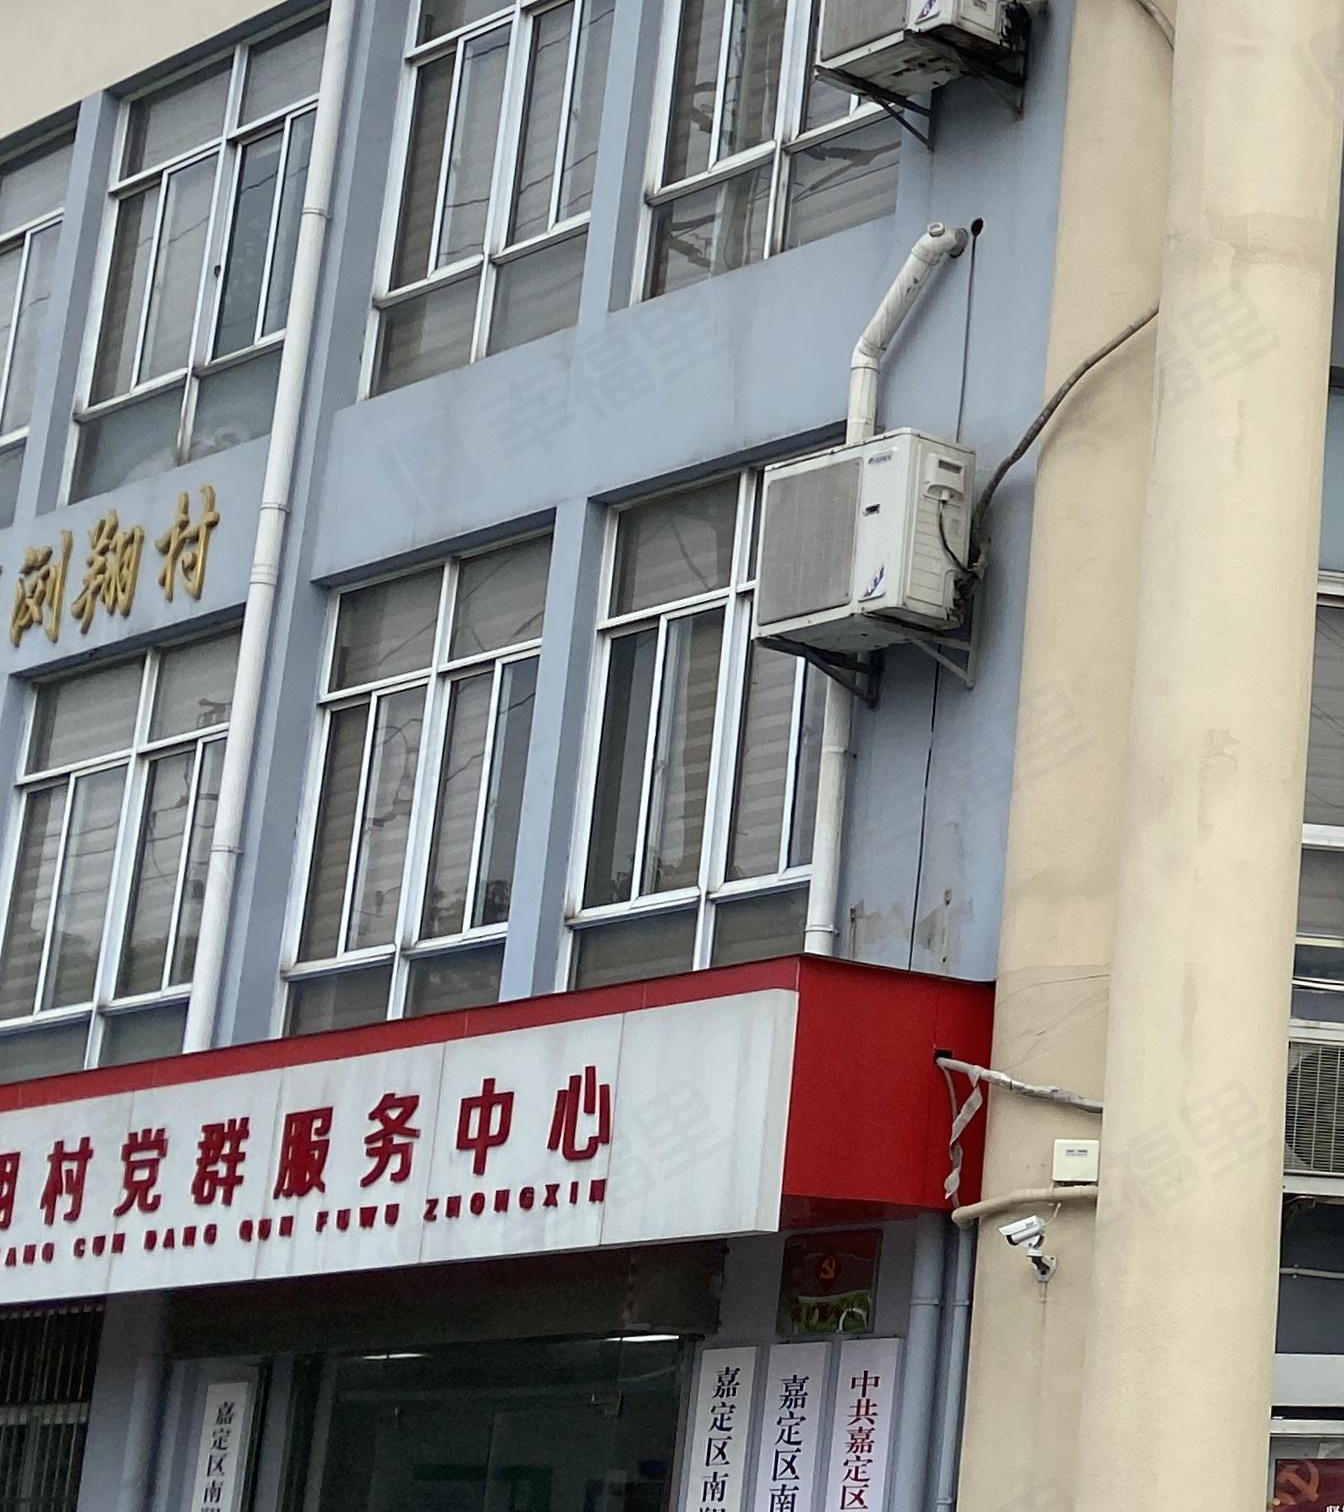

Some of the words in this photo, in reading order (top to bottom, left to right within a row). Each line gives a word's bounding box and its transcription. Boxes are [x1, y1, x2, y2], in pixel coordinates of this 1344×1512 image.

[315, 1203, 400, 1233] FUWU
[423, 1178, 607, 1221] ZHONGXIN
[200, 1400, 236, 1512] 嘉定区南
[701, 1366, 741, 1512] 嘉定区南
[839, 1370, 880, 1510] 中共嘉定区
